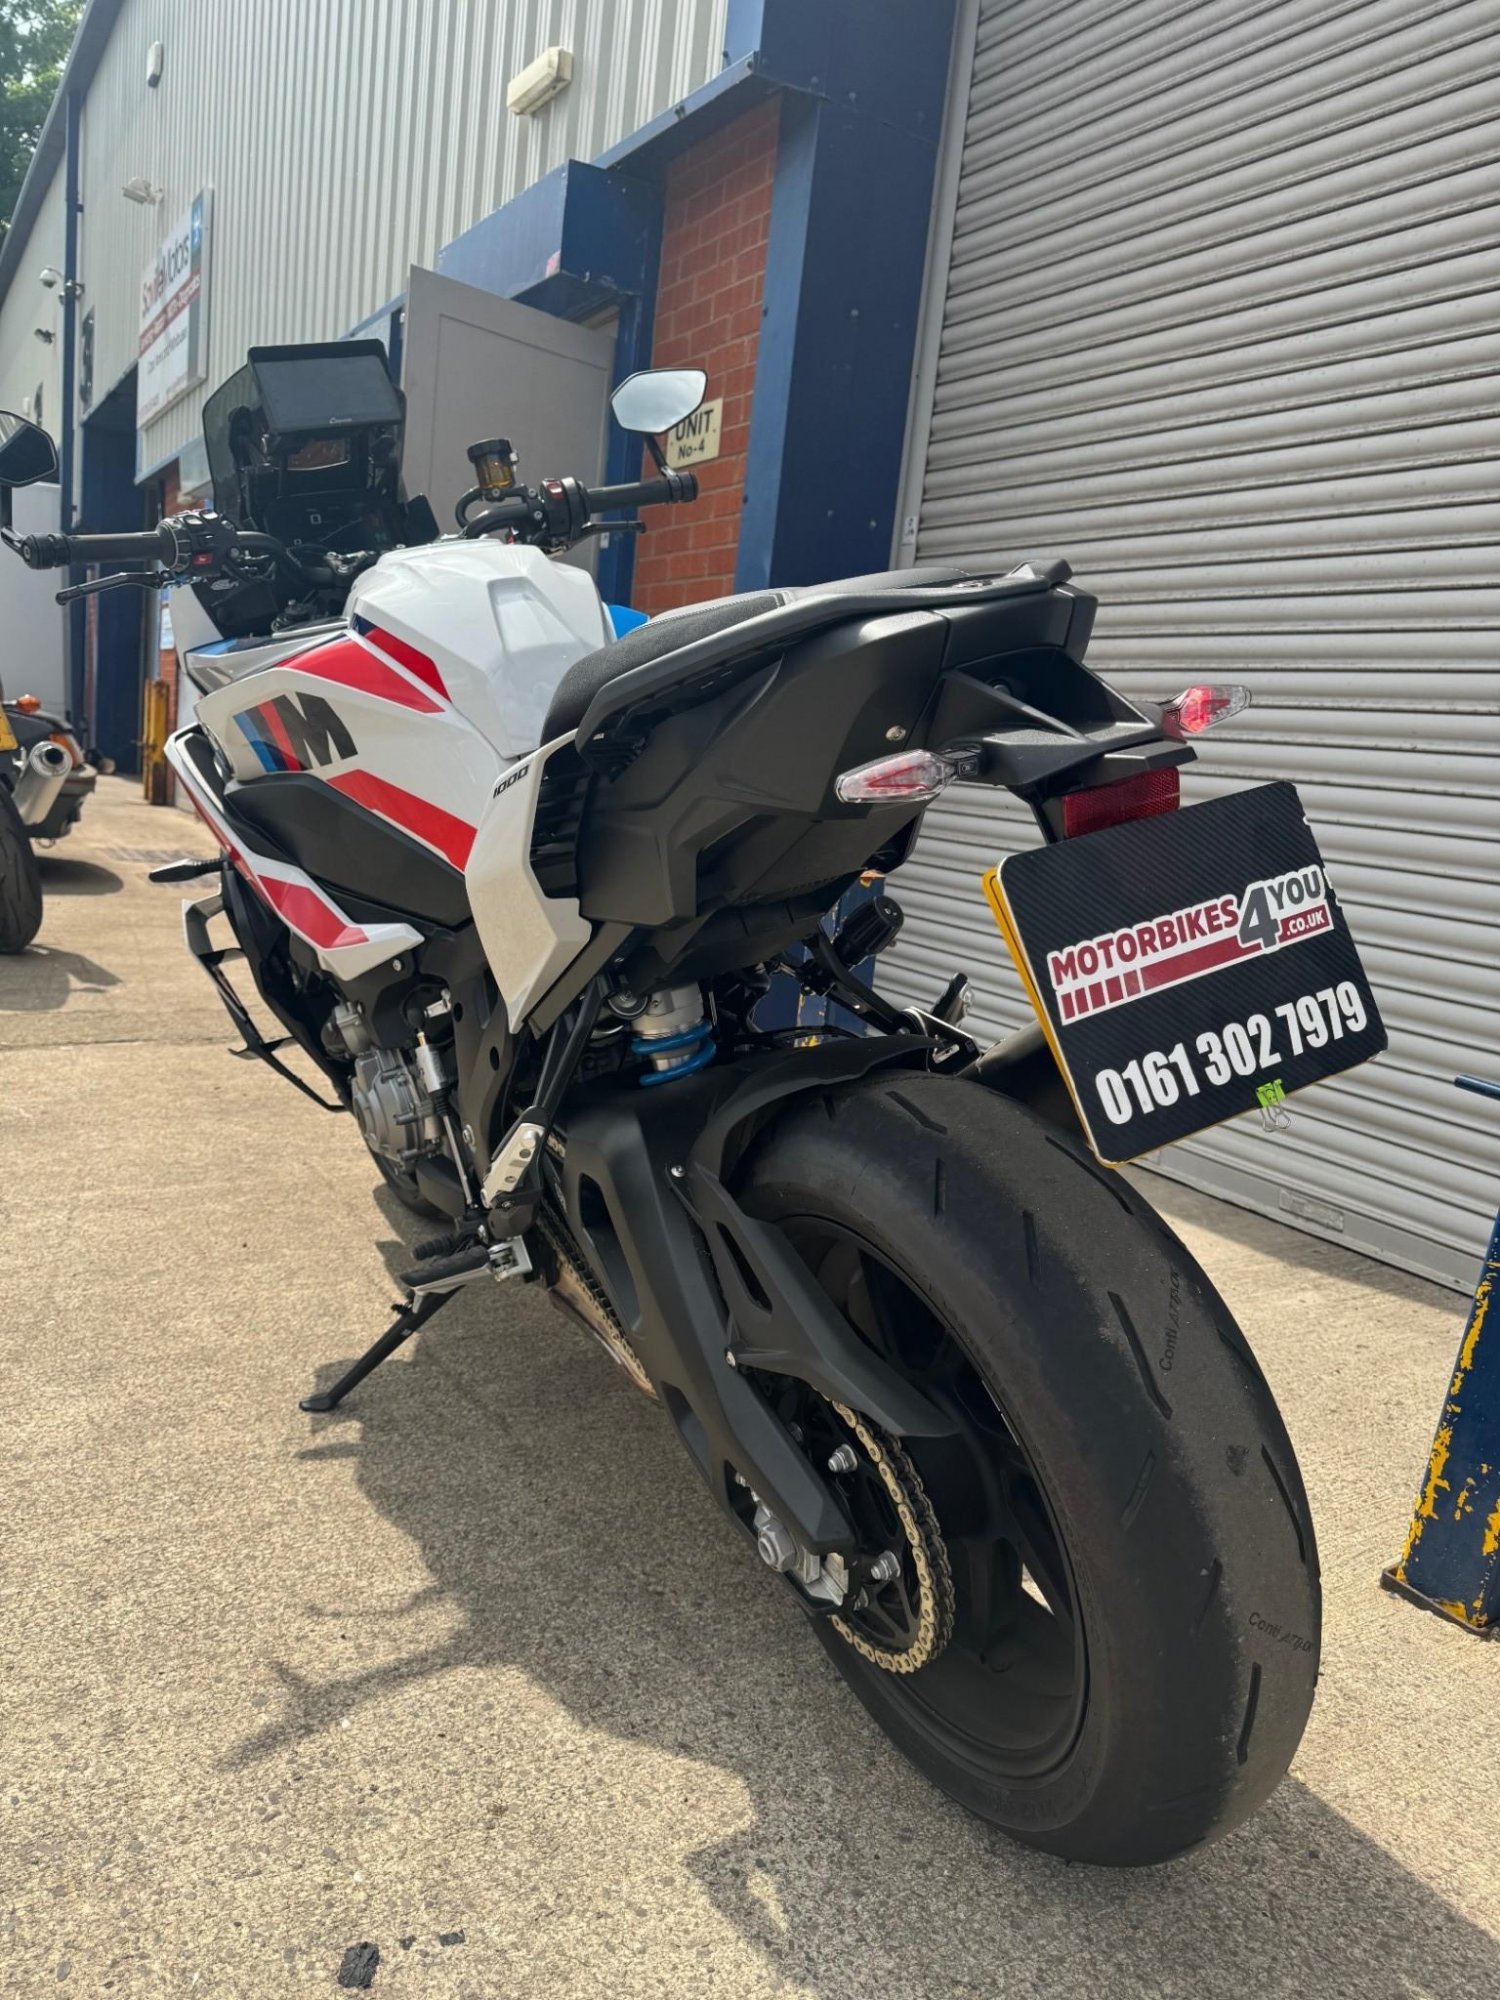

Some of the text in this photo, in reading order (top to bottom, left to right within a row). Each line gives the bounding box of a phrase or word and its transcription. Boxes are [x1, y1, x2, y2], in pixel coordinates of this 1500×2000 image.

[676, 409, 714, 441] UNIT
[678, 439, 705, 460] No-4
[493, 764, 530, 799] 1000
[1095, 980, 1368, 1125] 0161 302 7979
